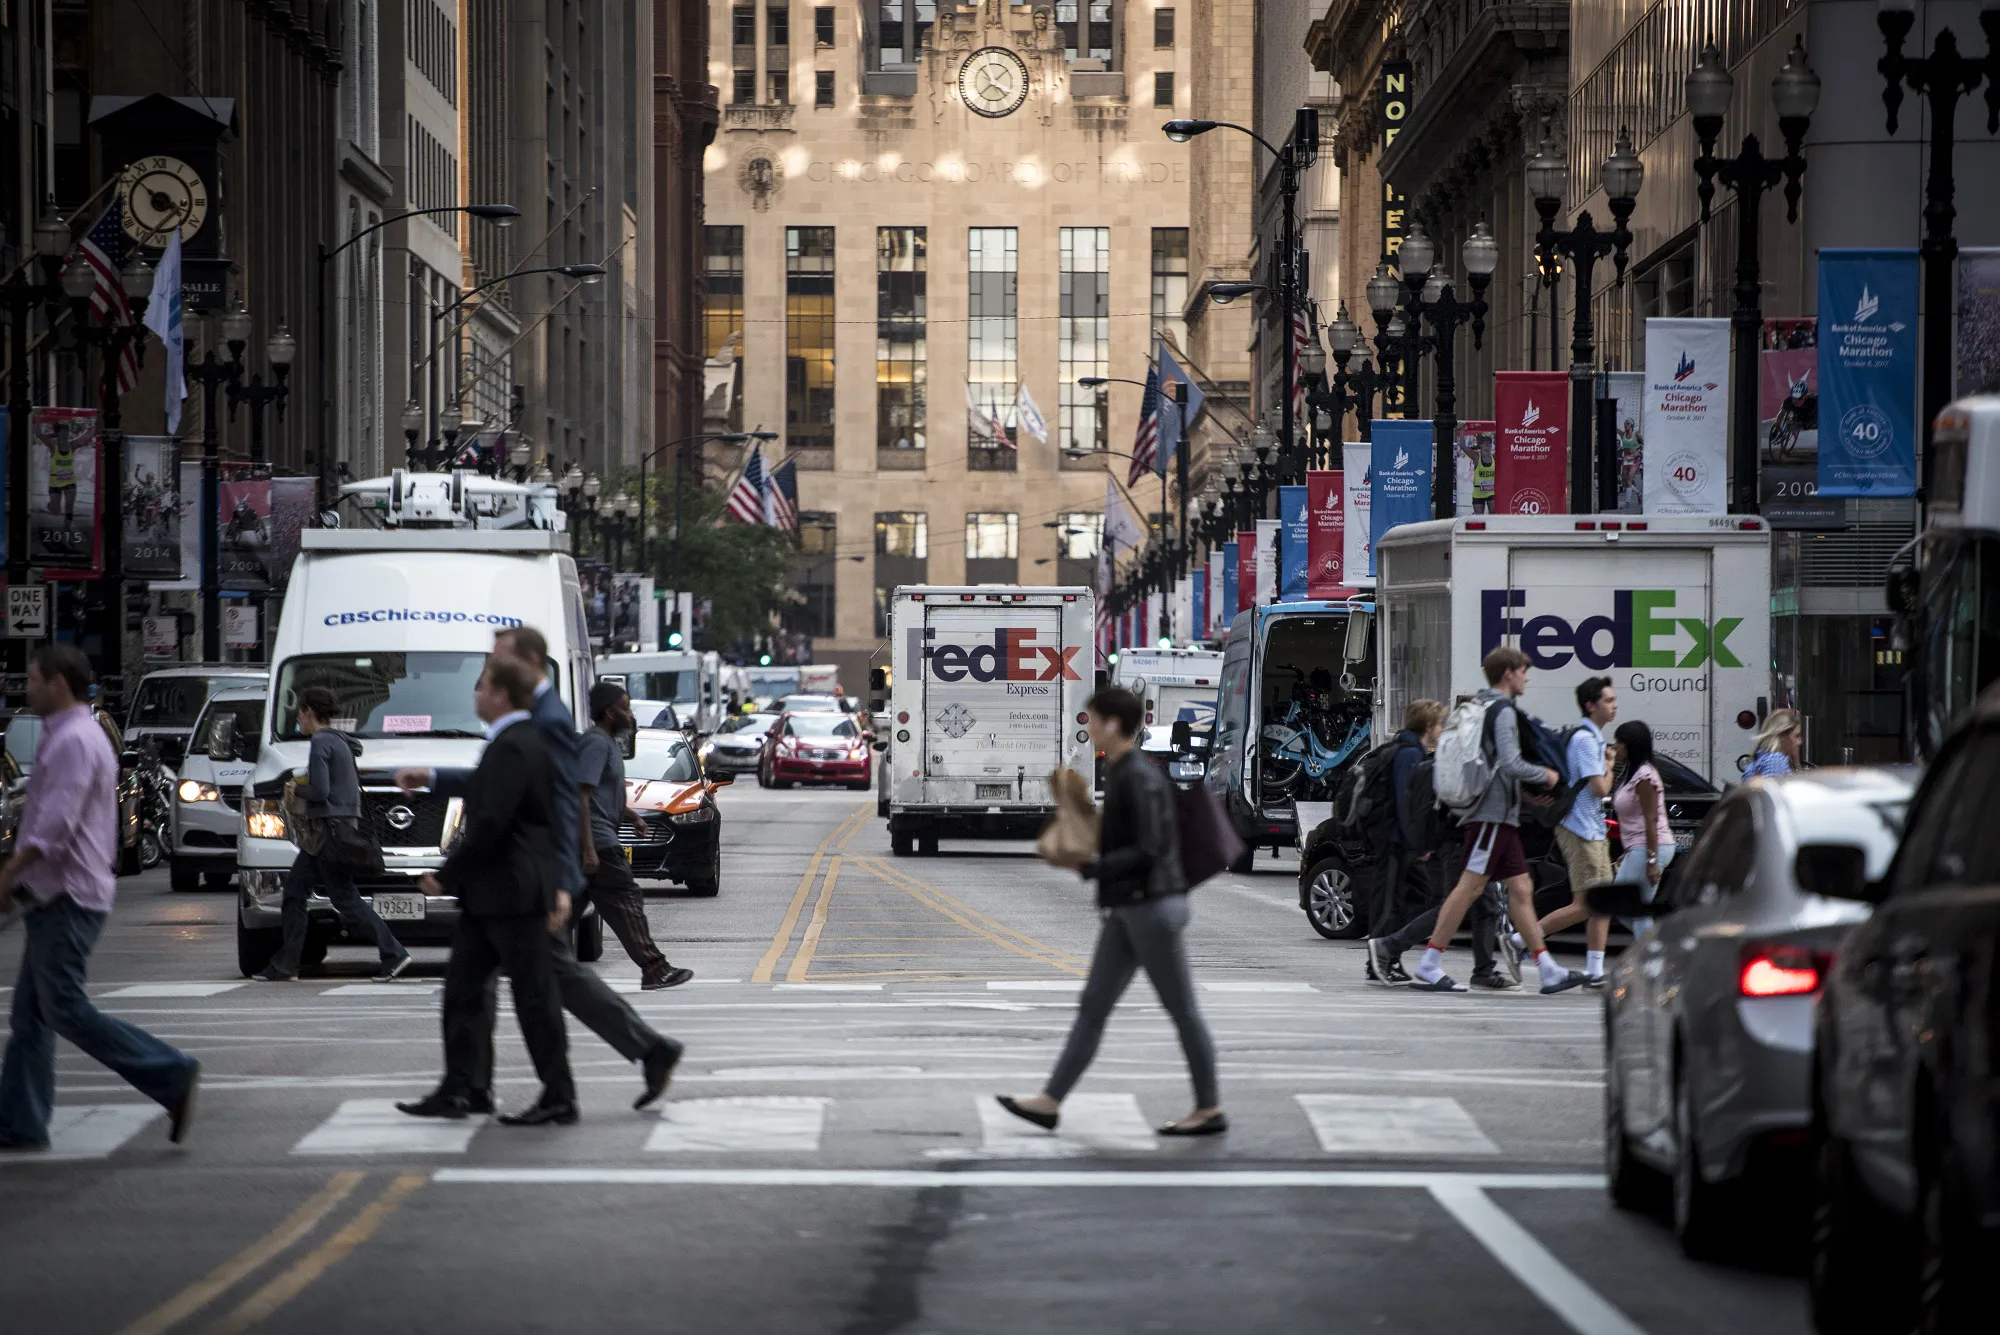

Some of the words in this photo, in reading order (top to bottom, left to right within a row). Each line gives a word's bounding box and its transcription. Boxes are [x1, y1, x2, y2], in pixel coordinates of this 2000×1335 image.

[807, 161, 936, 183] CHICAGO
[949, 161, 1040, 183] BOARD
[1053, 162, 1087, 183] OF
[1100, 162, 1186, 183] TRADE
[1385, 73, 1406, 283] NOERN
[1831, 323, 1849, 333] Bank
[1857, 324, 1887, 333] America
[1844, 334, 1888, 348] Chicago
[1839, 345, 1893, 357] Marathon
[1874, 360, 1890, 368] 2017
[1665, 392, 1702, 404] Chicago
[1661, 403, 1706, 412] Marathon
[1852, 422, 1879, 441] 40
[1514, 436, 1546, 445] Chicago
[1510, 444, 1549, 452] Marathon
[1674, 467, 1696, 481] 40
[1833, 471, 1898, 480] #ChicagoMarathon
[1387, 477, 1414, 486] Chicago
[1384, 484, 1417, 492] Marathon
[1776, 481, 1815, 496] 200
[1520, 501, 1540, 514] 40
[42, 531, 83, 544] 2015
[134, 547, 171, 558] 2014
[229, 561, 261, 572] 2008
[1325, 561, 1339, 570] 40
[10, 590, 41, 603] ONE
[10, 604, 42, 617] WAY
[324, 608, 523, 628] CBSChicago.com
[1481, 589, 1745, 670] FedEx
[907, 627, 1082, 682] FedEx
[1630, 673, 1707, 692] Ground
[1006, 683, 1049, 697] Express
[1009, 711, 1049, 720] fedex.com
[1651, 729, 1700, 741] ex.com
[991, 741, 1014, 749] World
[1016, 741, 1027, 749] On
[1028, 741, 1048, 749] Time
